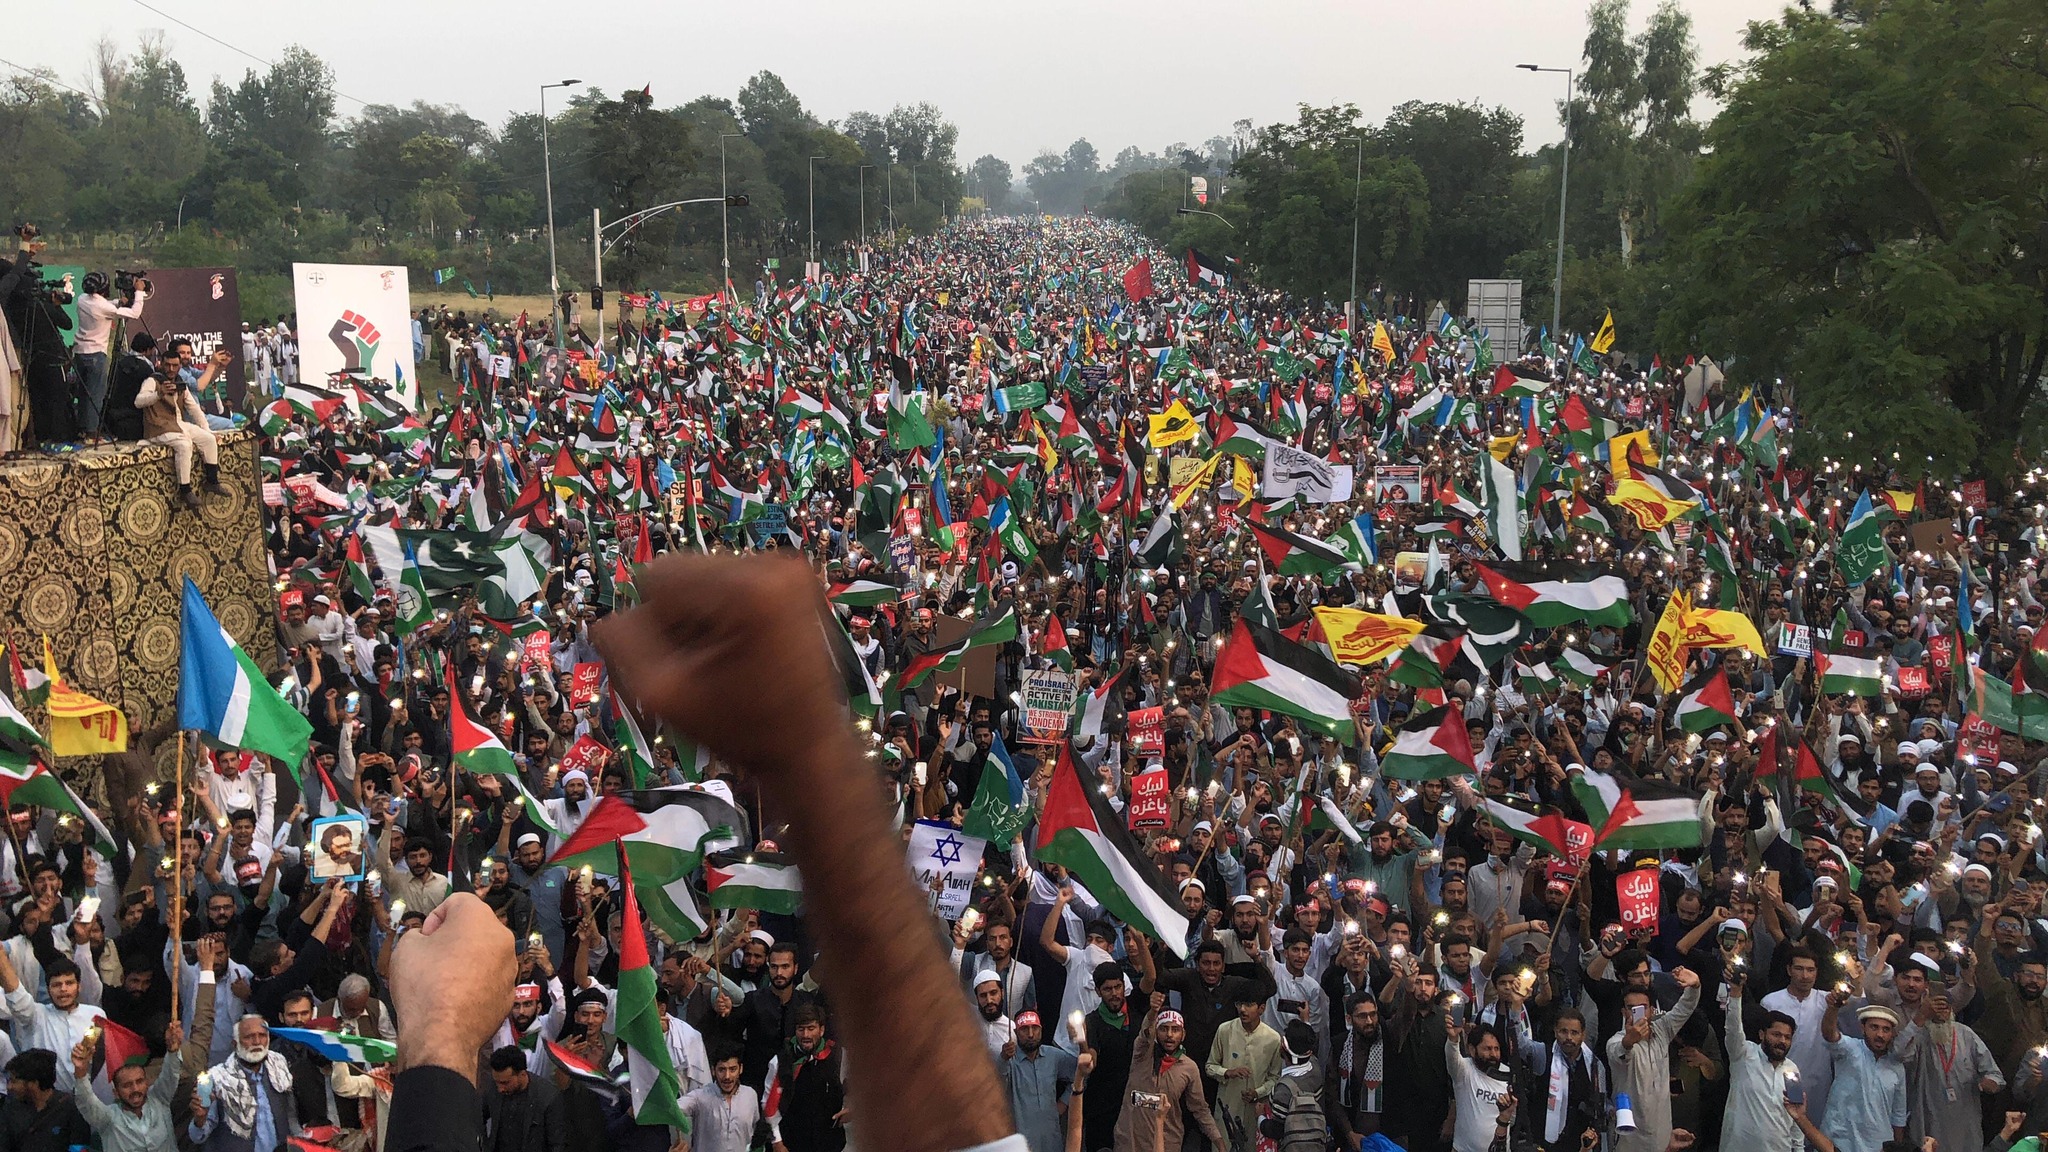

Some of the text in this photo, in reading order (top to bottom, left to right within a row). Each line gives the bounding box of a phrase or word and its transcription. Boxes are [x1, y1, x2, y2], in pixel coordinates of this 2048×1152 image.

[204, 332, 223, 341] THE
[192, 356, 207, 365] THE
[577, 666, 599, 682] لبيك
[1904, 671, 1922, 686] لبيك
[1029, 679, 1044, 687] PRO
[1028, 691, 1071, 701] ACTIVE IN
[1027, 699, 1070, 711] PAKISTAN
[1029, 709, 1066, 718] WE STRONGLY
[1027, 717, 1065, 729] CONDEMN
[1135, 712, 1159, 728] لبيك
[1137, 777, 1163, 796] لبيك
[1624, 875, 1654, 899] لبيك
